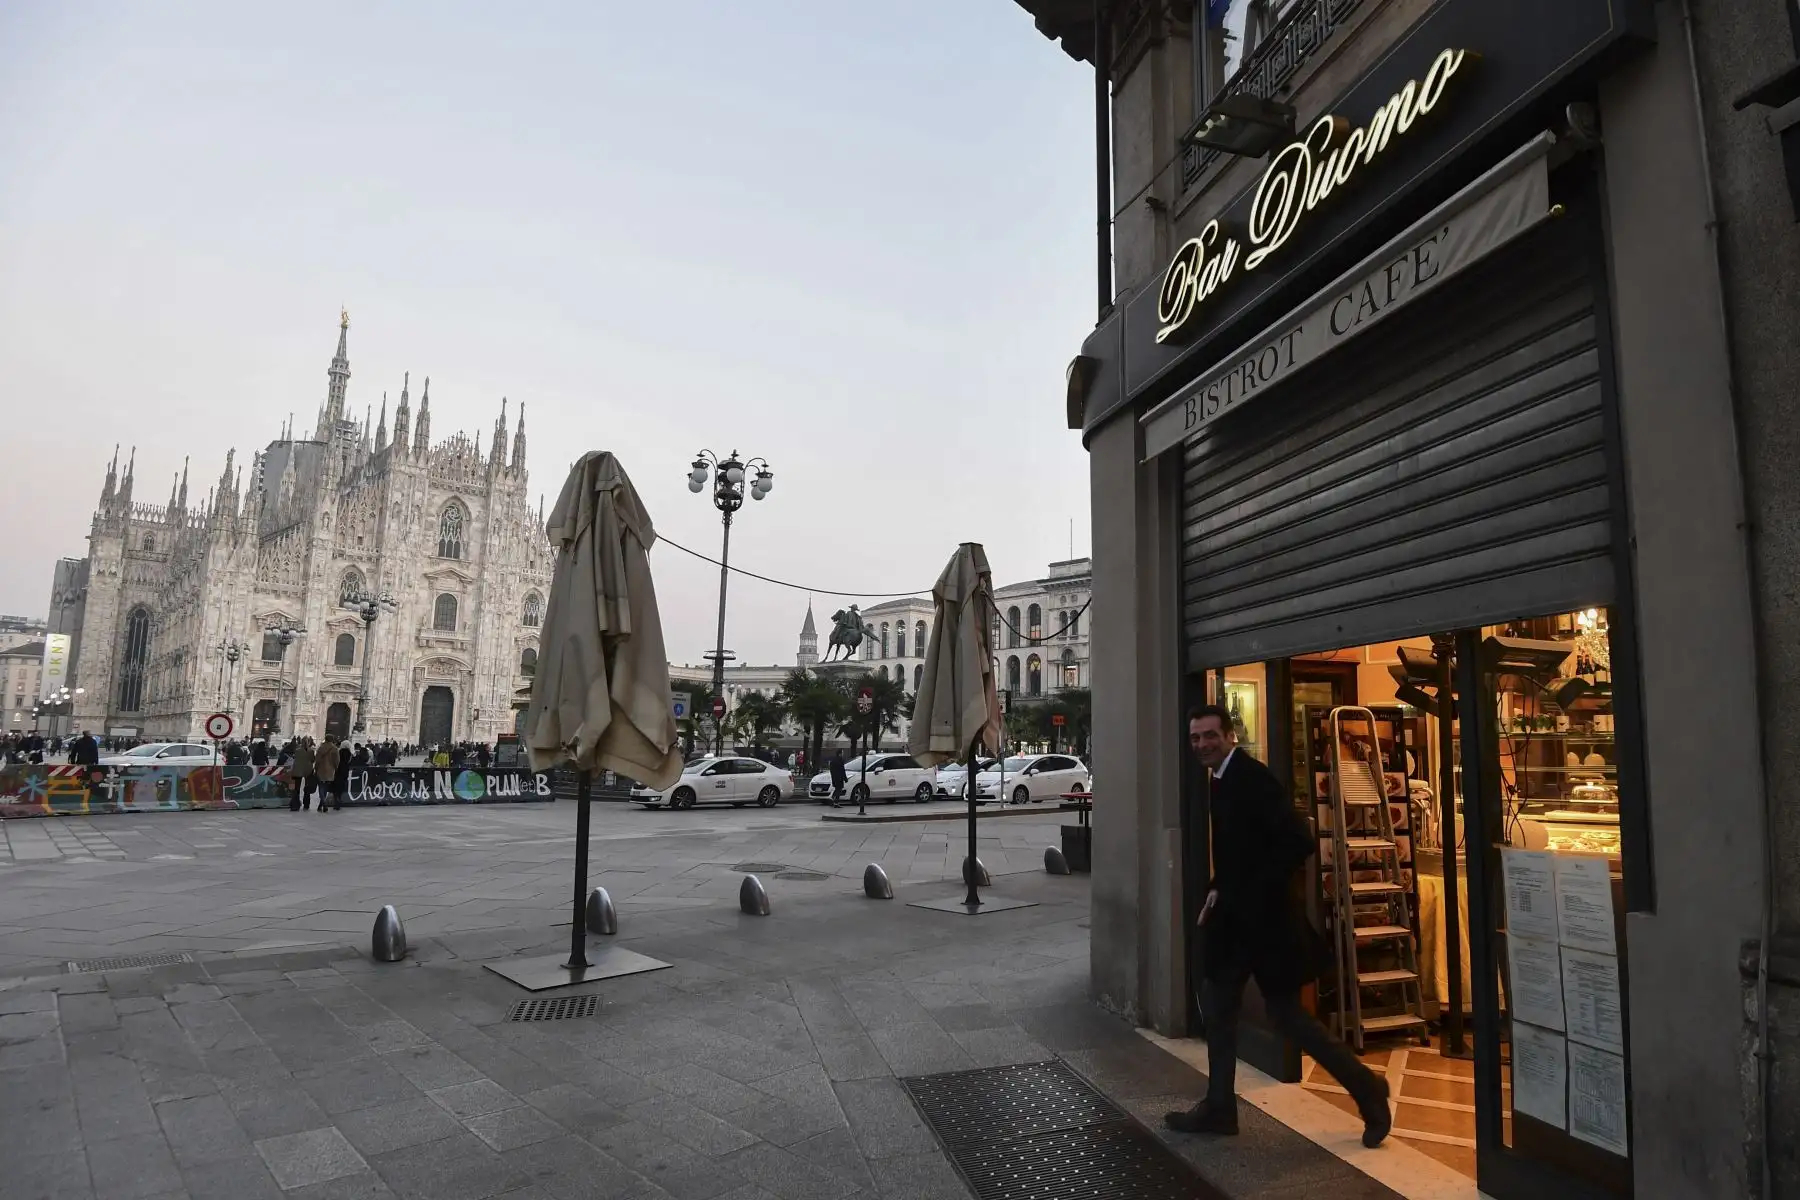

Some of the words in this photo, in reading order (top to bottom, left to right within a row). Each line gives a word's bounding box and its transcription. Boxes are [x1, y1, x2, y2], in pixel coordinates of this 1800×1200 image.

[1155, 218, 1241, 344] Bar
[1244, 47, 1465, 271] Duomo
[1183, 325, 1303, 431] BISTROT
[48, 634, 65, 676] DKNY
[347, 770, 408, 801] there
[410, 772, 430, 799] is
